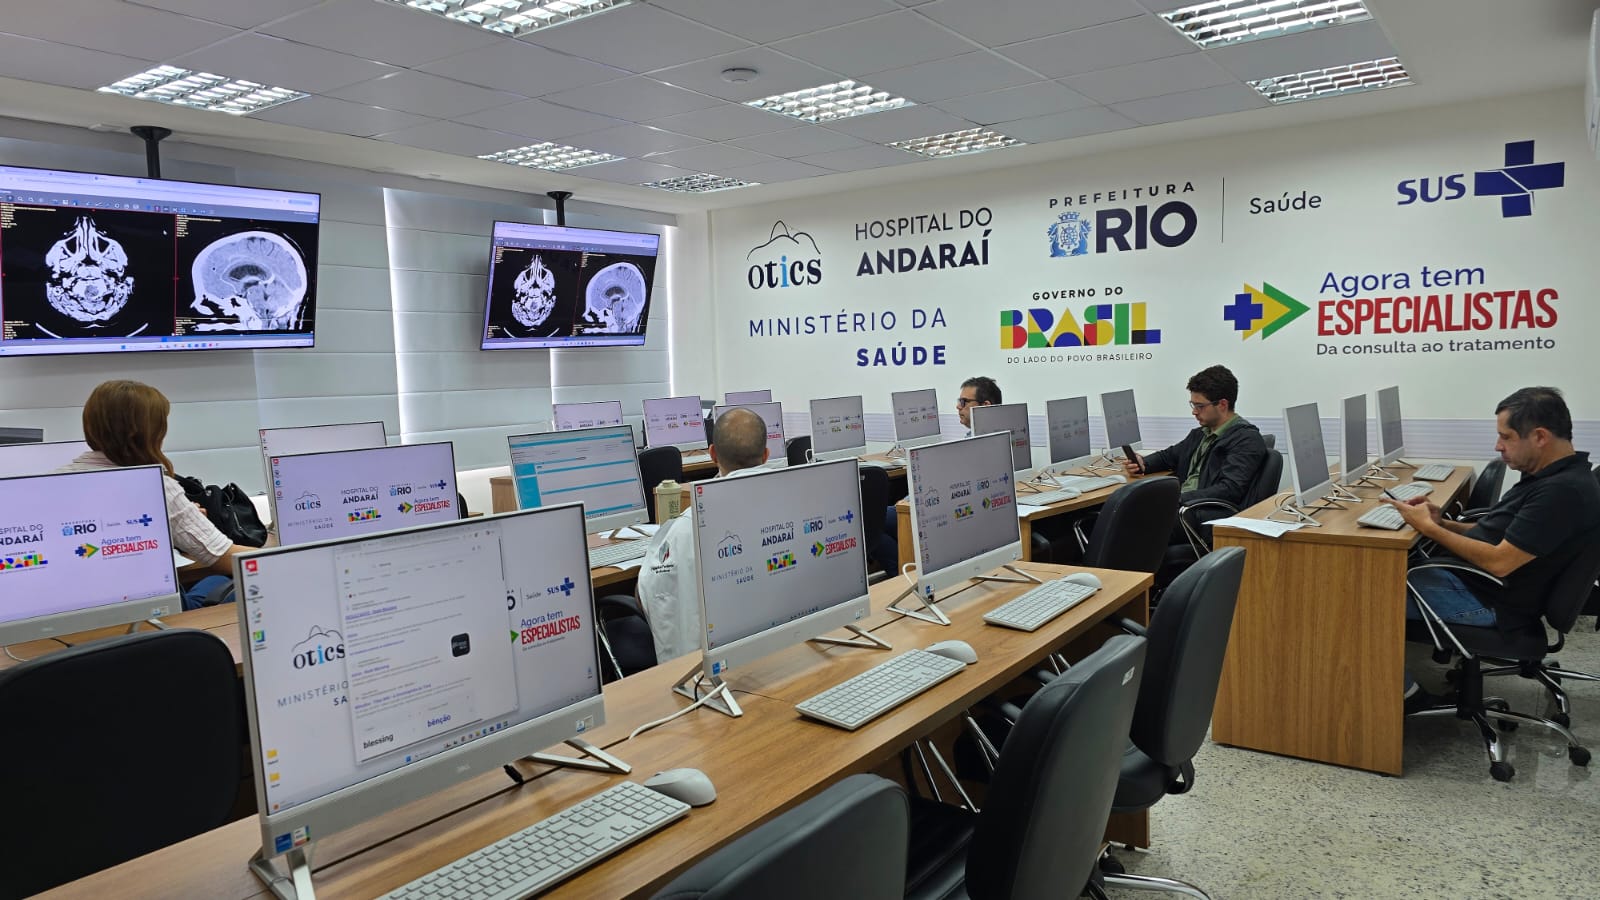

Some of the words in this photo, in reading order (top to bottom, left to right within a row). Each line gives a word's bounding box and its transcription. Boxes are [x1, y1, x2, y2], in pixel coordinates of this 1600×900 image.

[1050, 182, 1195, 208] PREFEITURA
[1397, 174, 1466, 205] SUS
[1249, 191, 1322, 214] Saúde
[855, 212, 953, 241] HOSPITAL
[960, 207, 993, 230] DO
[1095, 200, 1198, 254] RIO
[856, 229, 992, 277] ANDARAÍ
[748, 255, 822, 290] otics
[1320, 272, 1410, 298] Agora
[1421, 265, 1485, 289] tem
[1032, 287, 1097, 302] GOVERNO
[1105, 285, 1124, 297] DO
[749, 308, 896, 337] MINISTÉRIO
[912, 307, 947, 329] DA
[1317, 287, 1560, 337] ESPECIALISTAS
[1000, 302, 1162, 349] BRASIL
[857, 341, 947, 367] SAÚDE
[1007, 356, 1020, 364] DO
[1023, 355, 1047, 364] LADO
[1050, 355, 1064, 363] DO
[1067, 354, 1093, 363] POVO
[1096, 352, 1153, 362] BRASILEIRO
[1316, 344, 1339, 361] Da
[1342, 340, 1416, 360] consulta
[1422, 342, 1443, 358] ao
[1448, 336, 1556, 358] tratamento
[397, 486, 412, 495] RIO
[295, 500, 321, 511] otics
[74, 523, 97, 535] RIO
[762, 527, 794, 547] ANDARAÍ
[810, 520, 823, 533] RIO
[101, 538, 125, 546] Agora
[101, 540, 158, 556] ESPECIALISTAS
[718, 544, 743, 559] otics
[547, 585, 560, 595] SUS
[520, 616, 546, 628] Agora
[547, 610, 563, 620] tem
[521, 615, 580, 645] ESPECIALISTAS
[292, 643, 346, 670] otics
[277, 680, 349, 707] MINISTÉRIO
[362, 733, 394, 749] blessing
